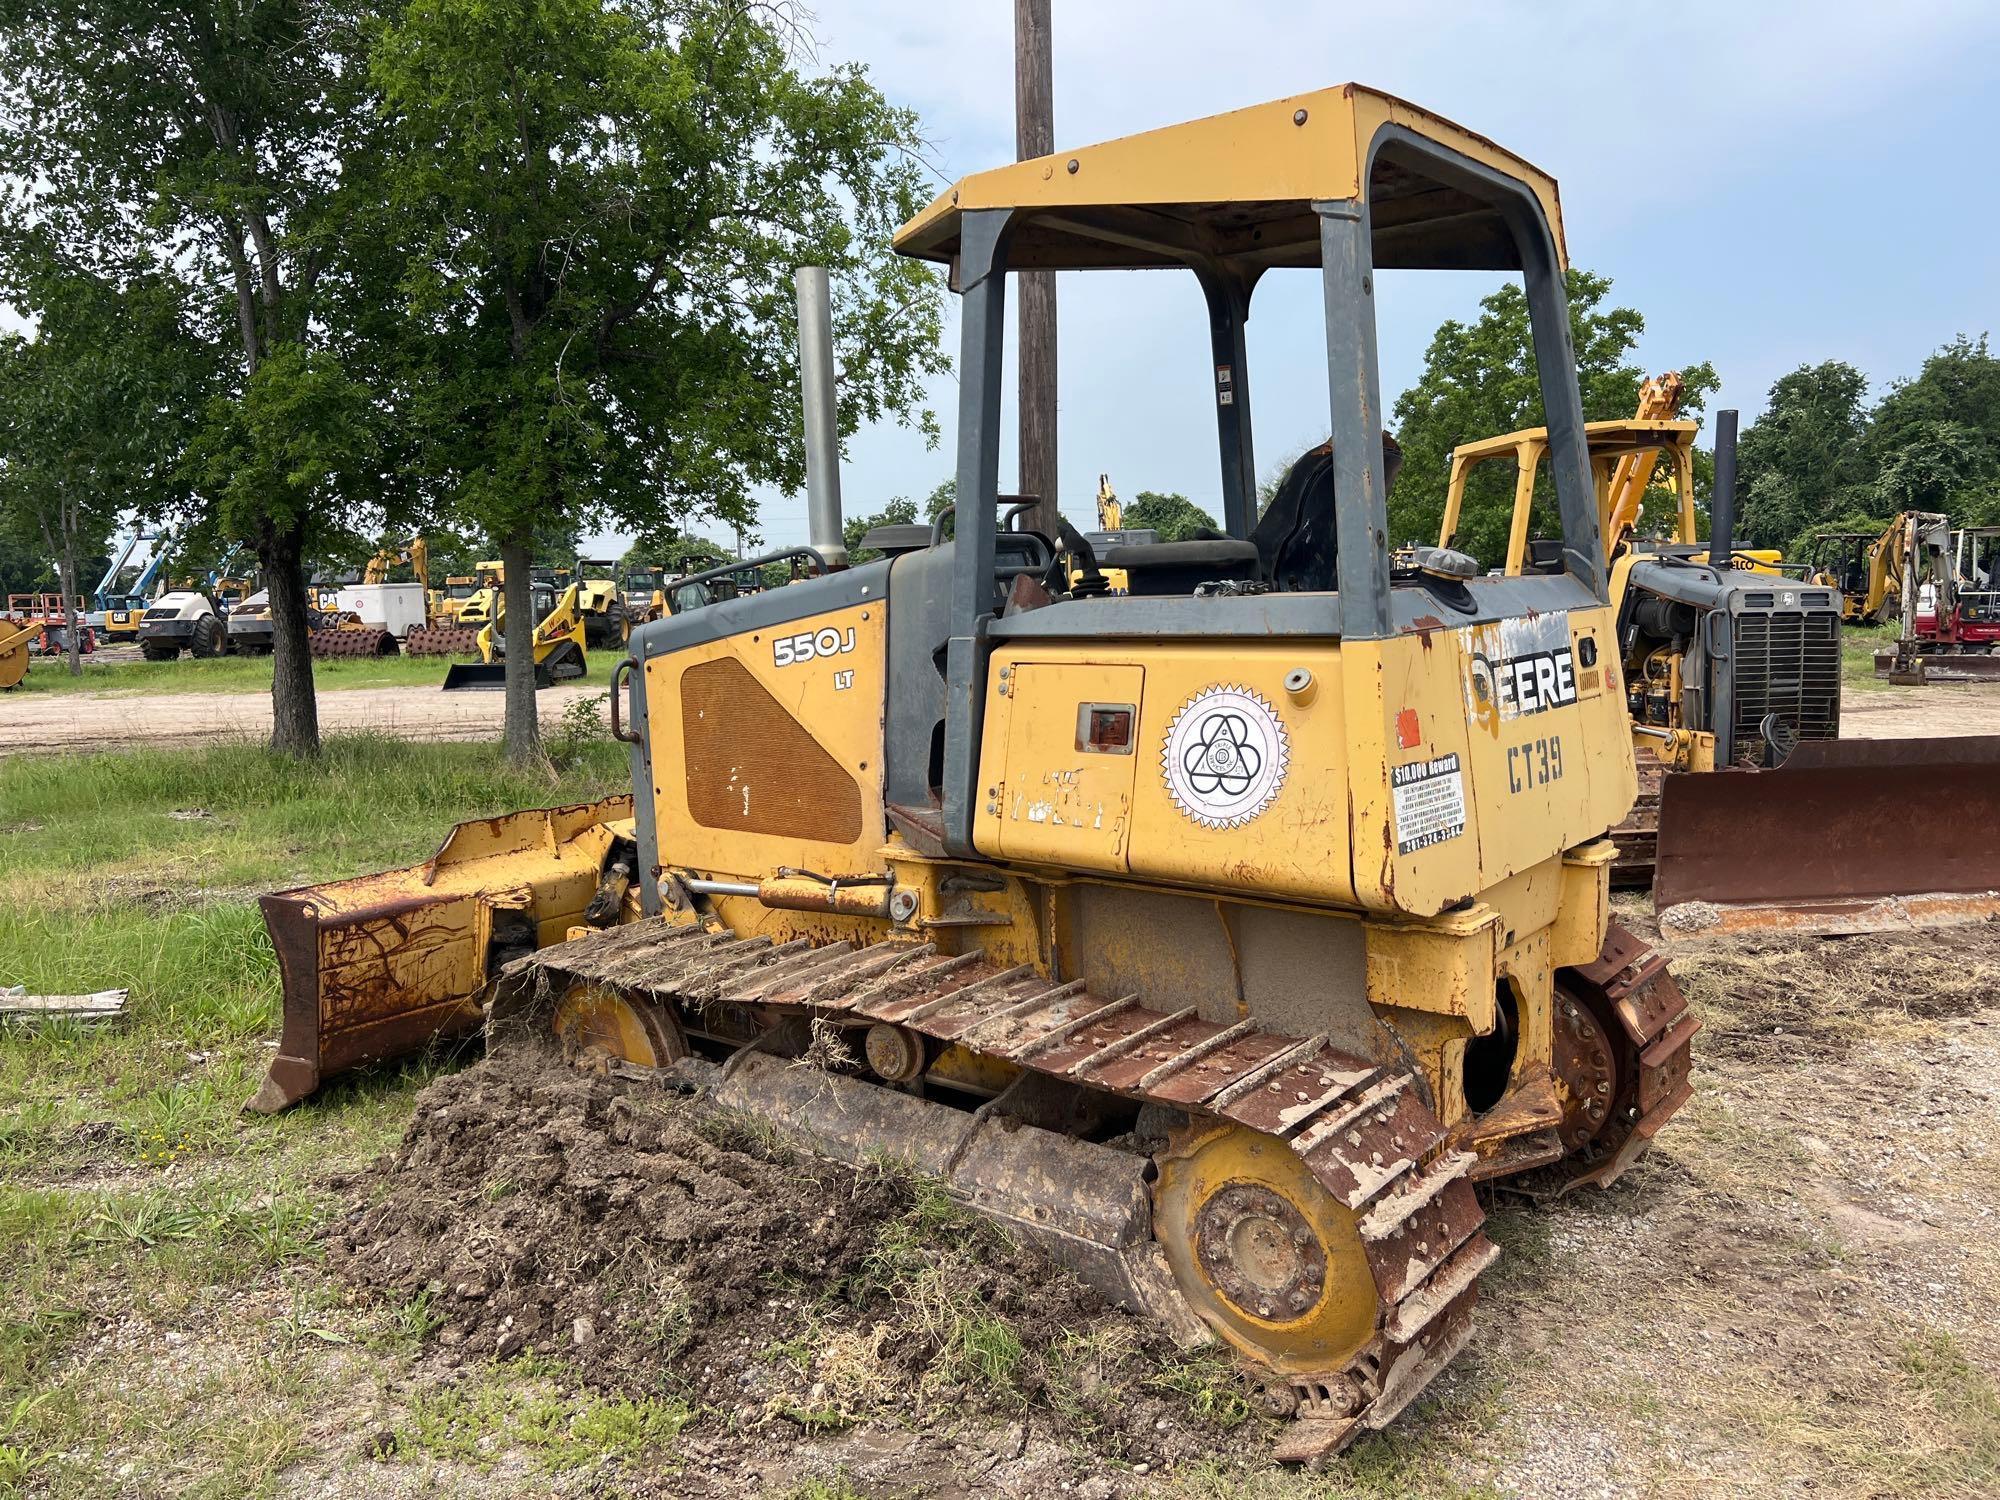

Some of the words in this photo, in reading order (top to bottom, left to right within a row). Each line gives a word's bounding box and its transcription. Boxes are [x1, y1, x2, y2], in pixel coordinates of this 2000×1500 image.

[113, 612, 127, 622] CAT
[772, 626, 856, 668] 550J
[833, 669, 855, 691] LT
[1428, 755, 1457, 776] Reward
[1507, 735, 1563, 794] CT39
